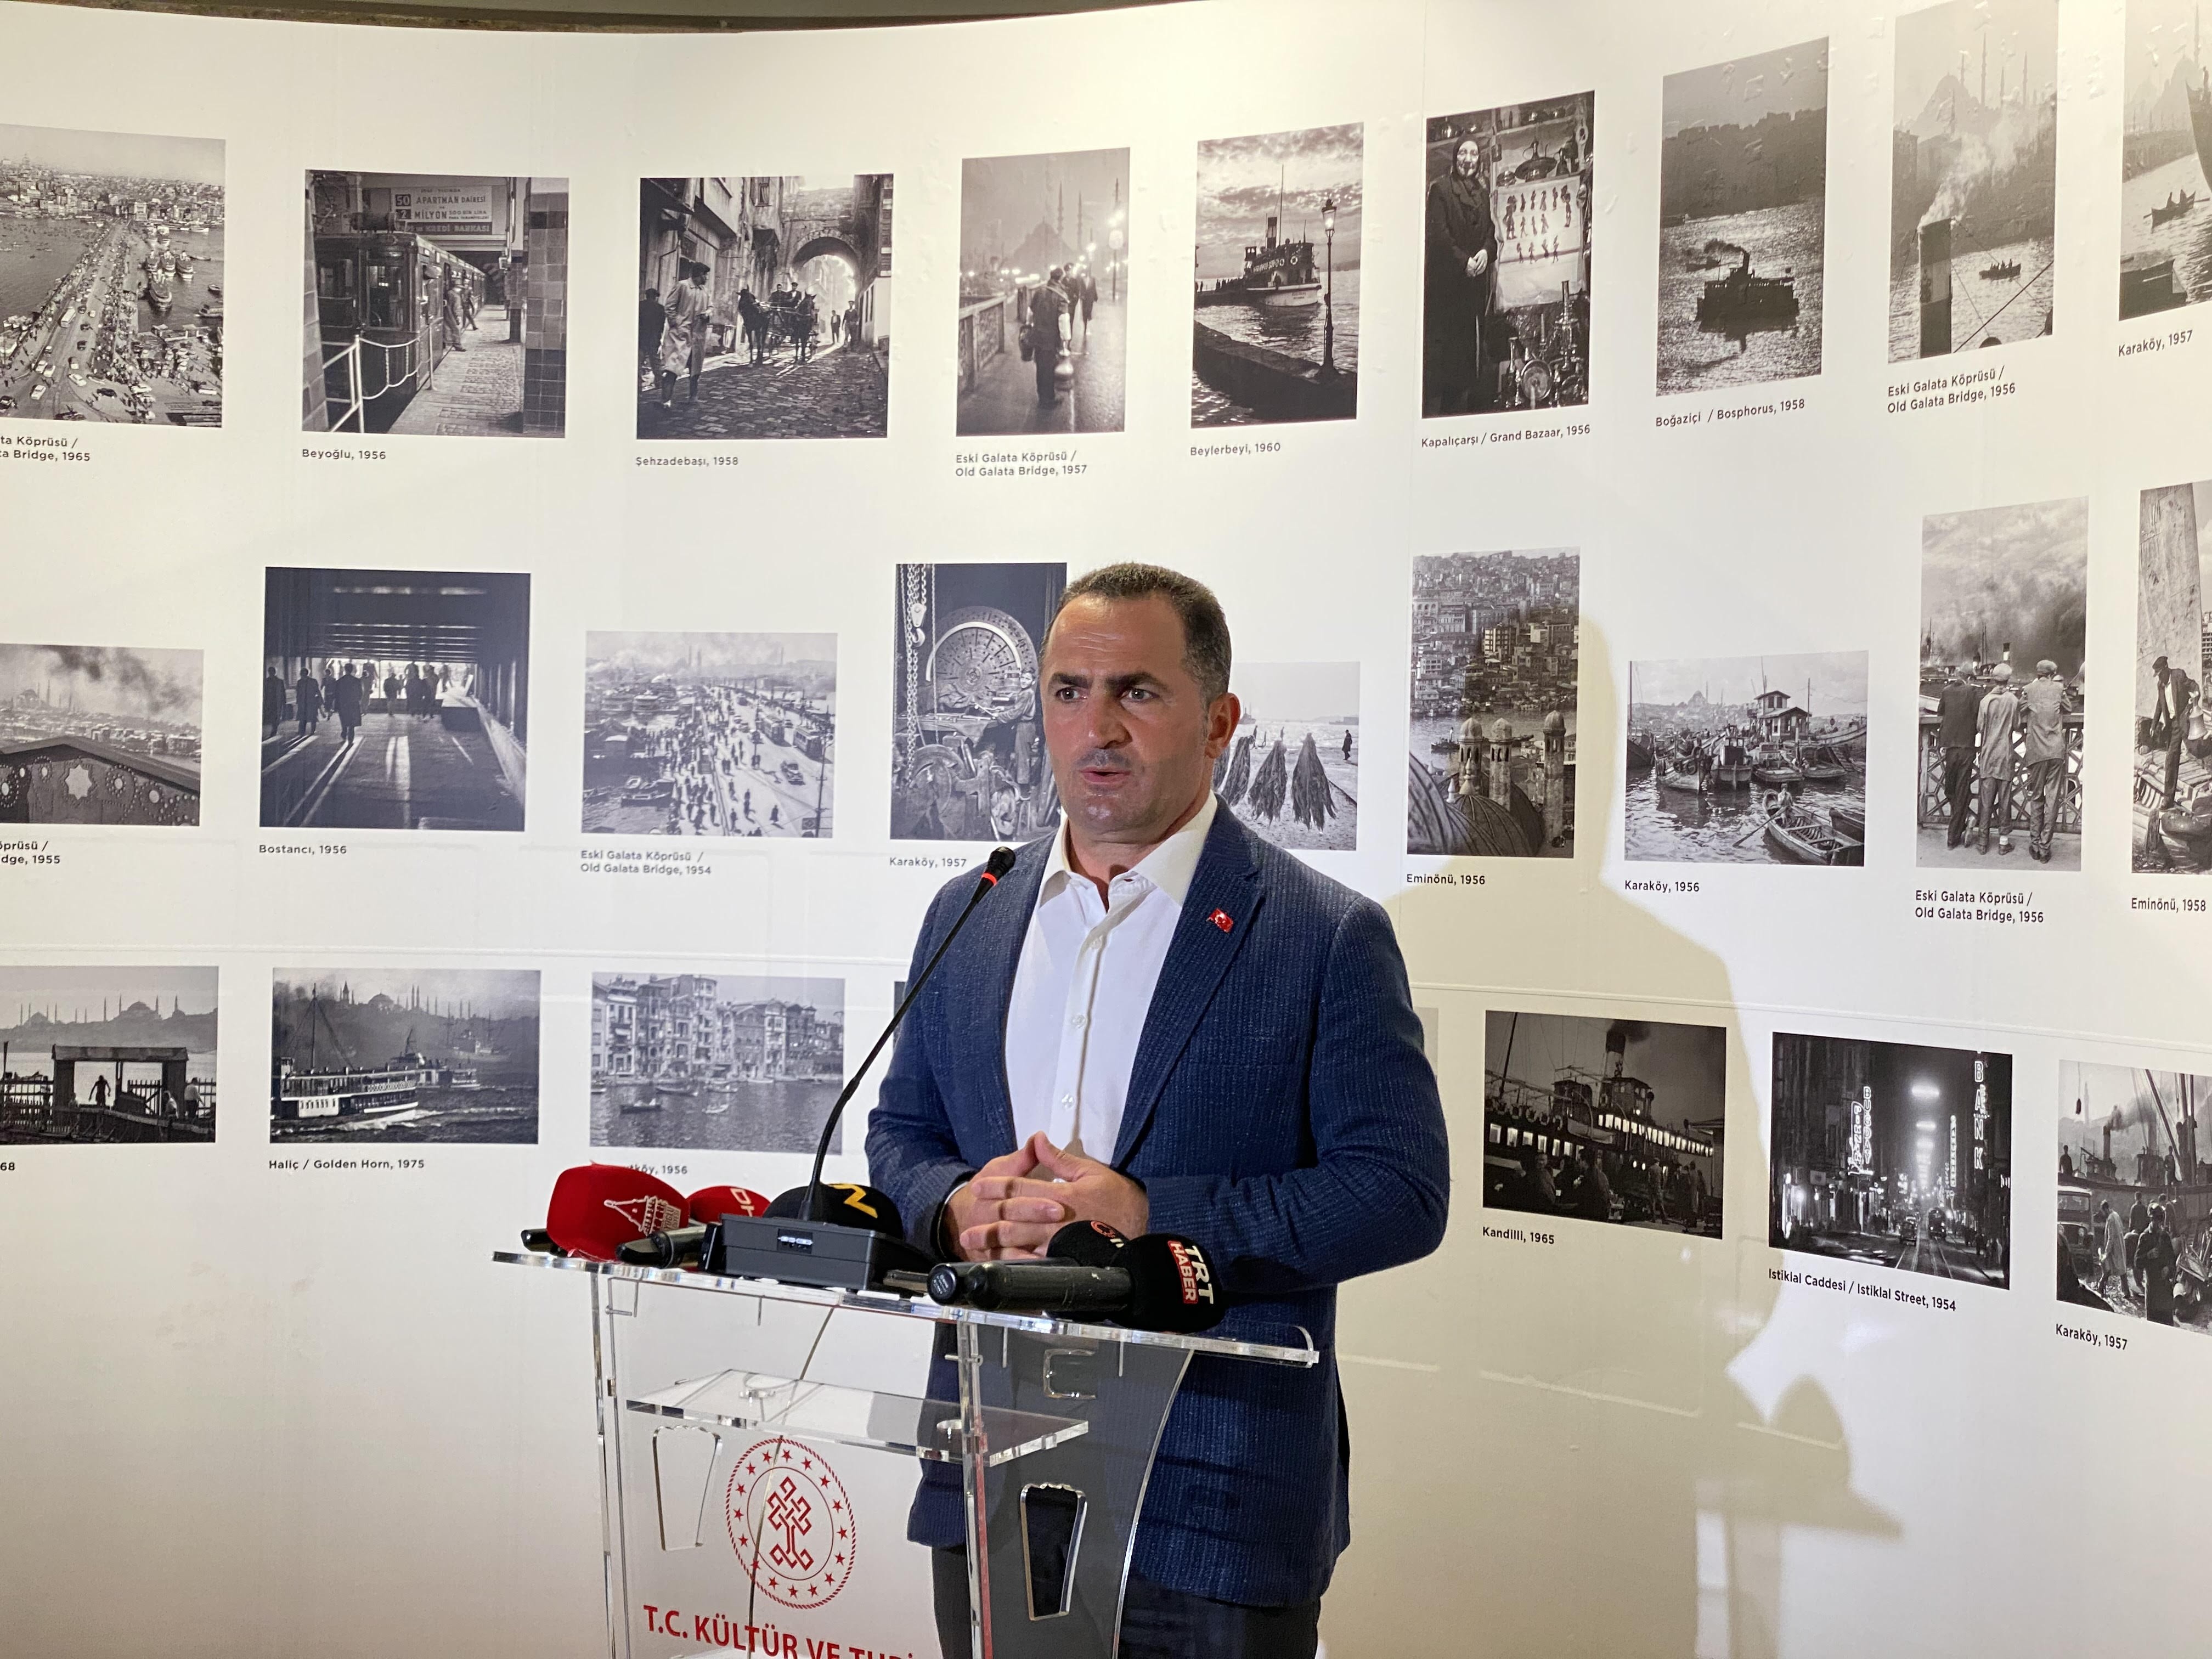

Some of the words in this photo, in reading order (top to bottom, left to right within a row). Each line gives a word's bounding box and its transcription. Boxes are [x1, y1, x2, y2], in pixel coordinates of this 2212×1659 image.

[396, 195, 410, 206] 50
[416, 196, 459, 204] APARTMAN
[400, 209, 407, 219] 2
[414, 210, 447, 219] MİLYON
[2118, 337, 2165, 357] Karaköy,
[2168, 329, 2193, 346] 1957
[1888, 382, 1910, 397] Eski
[1913, 378, 1947, 393] Galata
[1951, 368, 1995, 387] Köprüsü
[1998, 365, 2005, 381] /
[1887, 399, 1906, 414] Old
[1910, 396, 1944, 410] Galata
[1948, 390, 1987, 404] Bridge,
[1990, 382, 2016, 397] 1956
[1656, 411, 1701, 427] Boğaziçi
[1707, 409, 1714, 423] /
[1717, 405, 1776, 420] Bosphorus,
[1780, 398, 1805, 411] 1958
[16, 436, 67, 448] Köprüsü
[71, 438, 78, 449] /
[1421, 436, 1479, 448] Kapalıçarşı
[1481, 432, 1487, 445] /
[1490, 430, 1522, 443] Grand
[1525, 429, 1563, 440] Bazaar,
[1566, 424, 1590, 436] 1956
[13, 449, 58, 462] Bridge,
[62, 452, 91, 461] 1965
[302, 449, 354, 460] Beyoğlu,
[358, 450, 386, 460] 1956
[1190, 443, 1251, 457] Beylerbeyi,
[1255, 442, 1281, 453] 1960
[635, 456, 709, 467] Şehzadebaşı,
[713, 456, 738, 466] 1958
[956, 453, 978, 464] Eski
[981, 453, 1018, 463] Galata
[1022, 451, 1067, 463] Köprüsü
[1070, 450, 1077, 462] /
[955, 467, 975, 477] Old
[979, 466, 1014, 477] Galata
[1018, 465, 1059, 477] Bridge,
[1062, 464, 1087, 475] 1957
[41, 840, 49, 852] /
[259, 844, 315, 855] Bostancı,
[319, 845, 347, 854] 1956
[32, 855, 60, 864] 1955
[580, 850, 603, 860] Eski
[606, 850, 642, 860] Galata
[646, 851, 691, 862] Köprüsü
[697, 851, 704, 863] /
[889, 857, 938, 868] Karaköy,
[941, 857, 967, 867] 1957
[580, 862, 601, 872] Old
[603, 863, 640, 873] Galata
[642, 864, 683, 876] Bridge,
[686, 865, 712, 875] 1954
[1407, 873, 1457, 886] Eminönü,
[1460, 874, 1486, 885] 1956
[1625, 880, 1671, 893] Karaköy,
[1675, 881, 1700, 892] 1956
[1915, 889, 1937, 901] Eski
[1941, 890, 1975, 902] Galata
[1979, 891, 2024, 906] Köprüsü
[2026, 892, 2033, 907] /
[2131, 897, 2179, 913] Eminönü,
[2182, 899, 2206, 912] 1958
[1915, 906, 1934, 918] Old
[1938, 907, 1972, 920] Galata
[1976, 909, 2015, 924] Bridge,
[2019, 911, 2044, 923] 1956
[269, 1160, 299, 1171] Haliç
[302, 1158, 309, 1170] /
[313, 1159, 357, 1169] Golden
[361, 1159, 393, 1170] Horn,
[398, 1159, 425, 1169] 1975
[662, 1165, 688, 1175] 1956
[1482, 1226, 1526, 1243] Kandilli,
[1530, 1232, 1555, 1245] 1965
[1170, 1242, 1197, 1302] HABER
[1184, 1245, 1214, 1305] TRT
[1769, 1268, 1802, 1284] Istiklal
[1804, 1274, 1846, 1291] Caddesi
[1848, 1280, 1854, 1294] /
[1858, 1283, 1891, 1300] Istiklal
[1894, 1290, 1929, 1309] Street,
[1932, 1296, 1956, 1312] 1954
[2056, 1323, 2101, 1347] Karaköy,
[2104, 1334, 2128, 1351] 1957
[643, 1605, 688, 1639] T.C.
[695, 1613, 798, 1659] KÜLTÜR
